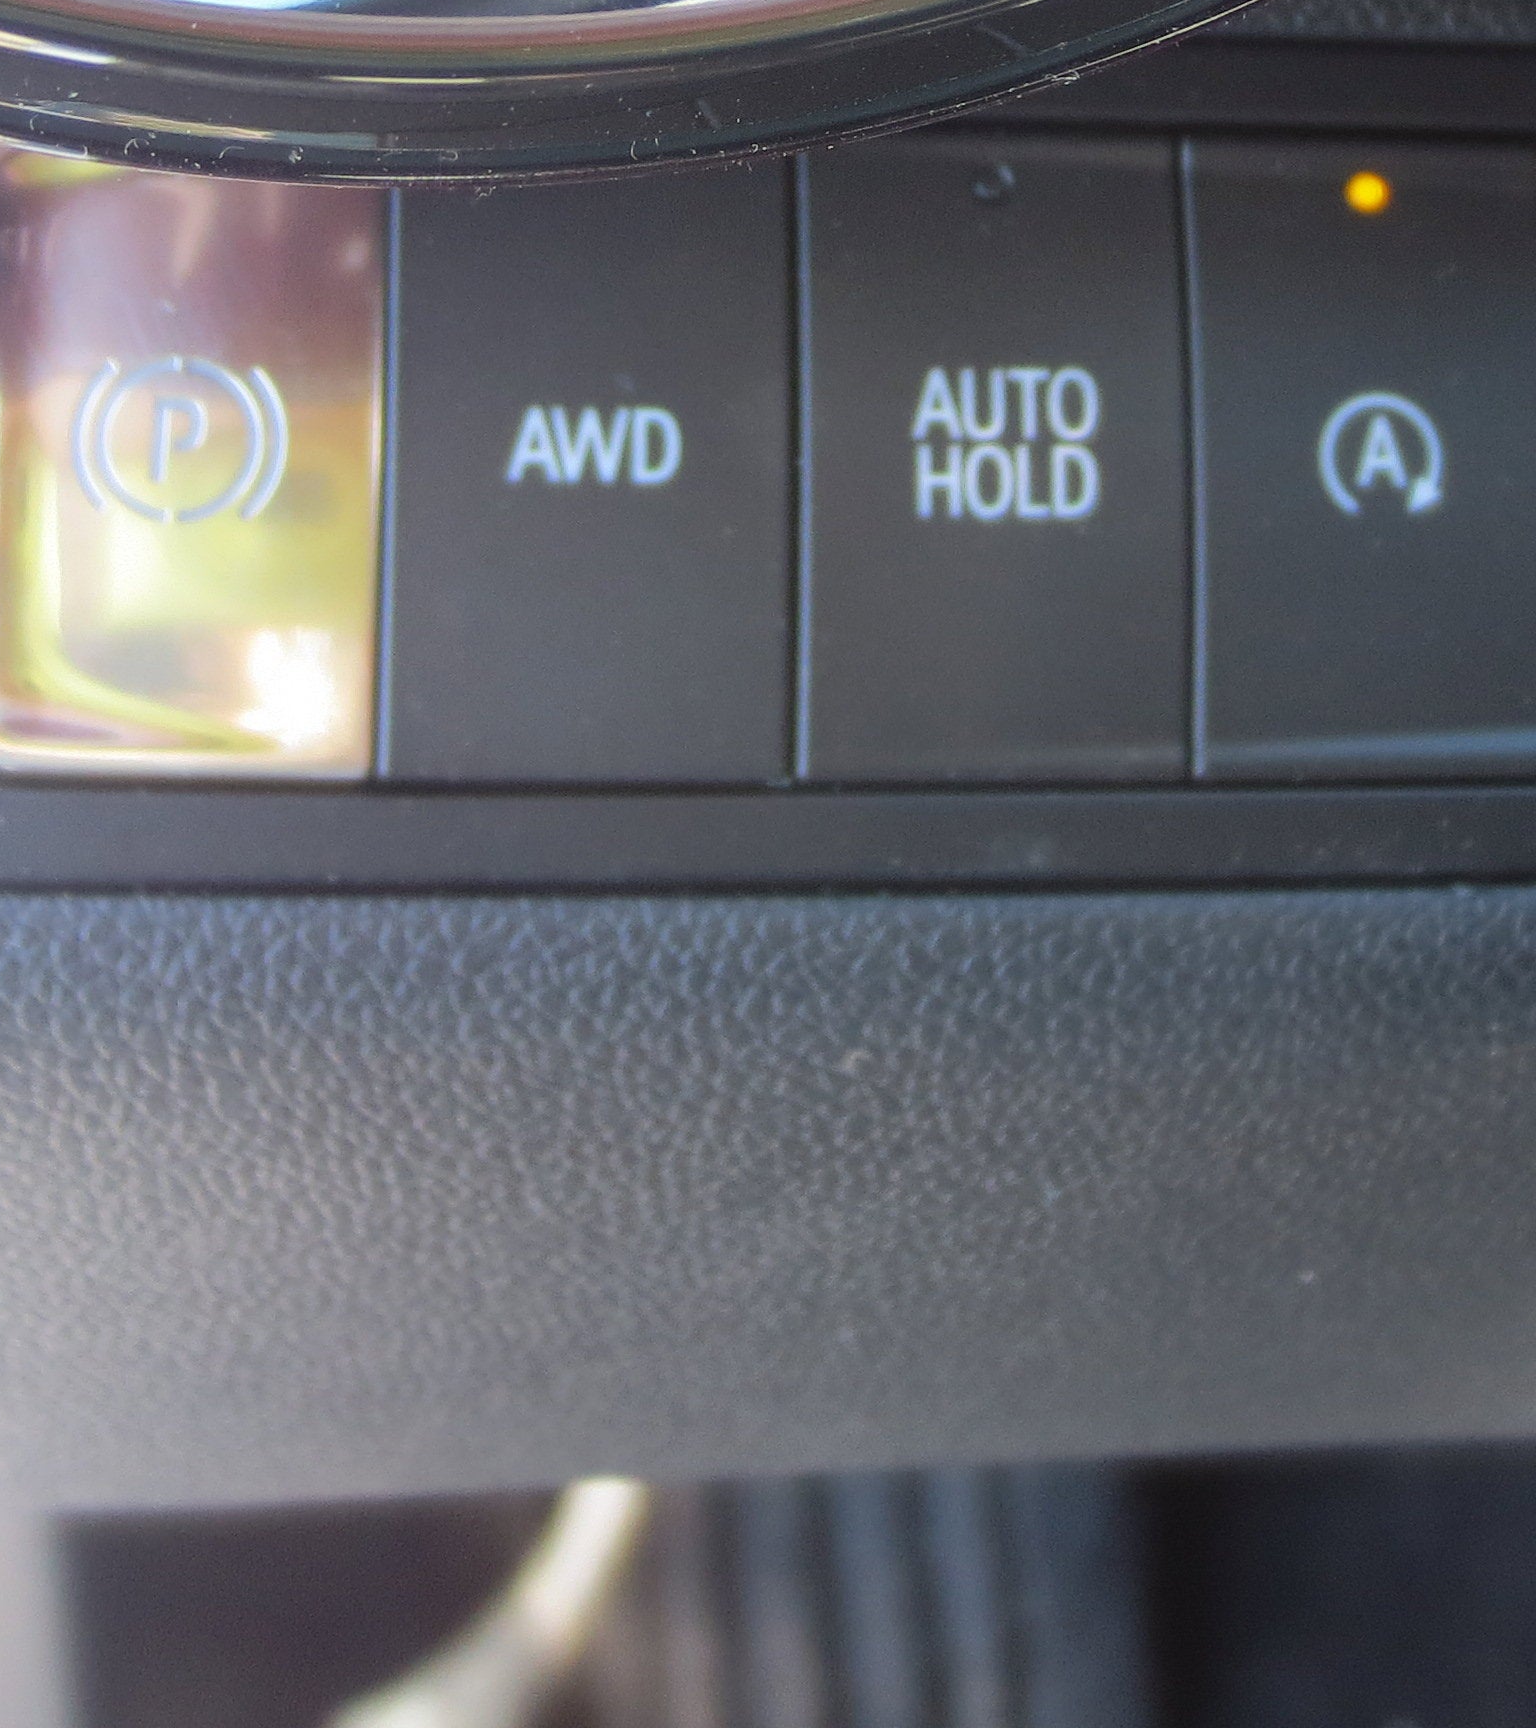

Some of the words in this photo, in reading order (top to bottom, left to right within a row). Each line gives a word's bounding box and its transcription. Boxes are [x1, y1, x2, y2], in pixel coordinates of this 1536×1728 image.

[150, 397, 208, 482] P
[911, 368, 1099, 441] AUTO
[506, 406, 681, 485] AWD
[915, 445, 1099, 520] HOLD
[1355, 414, 1408, 491] A
